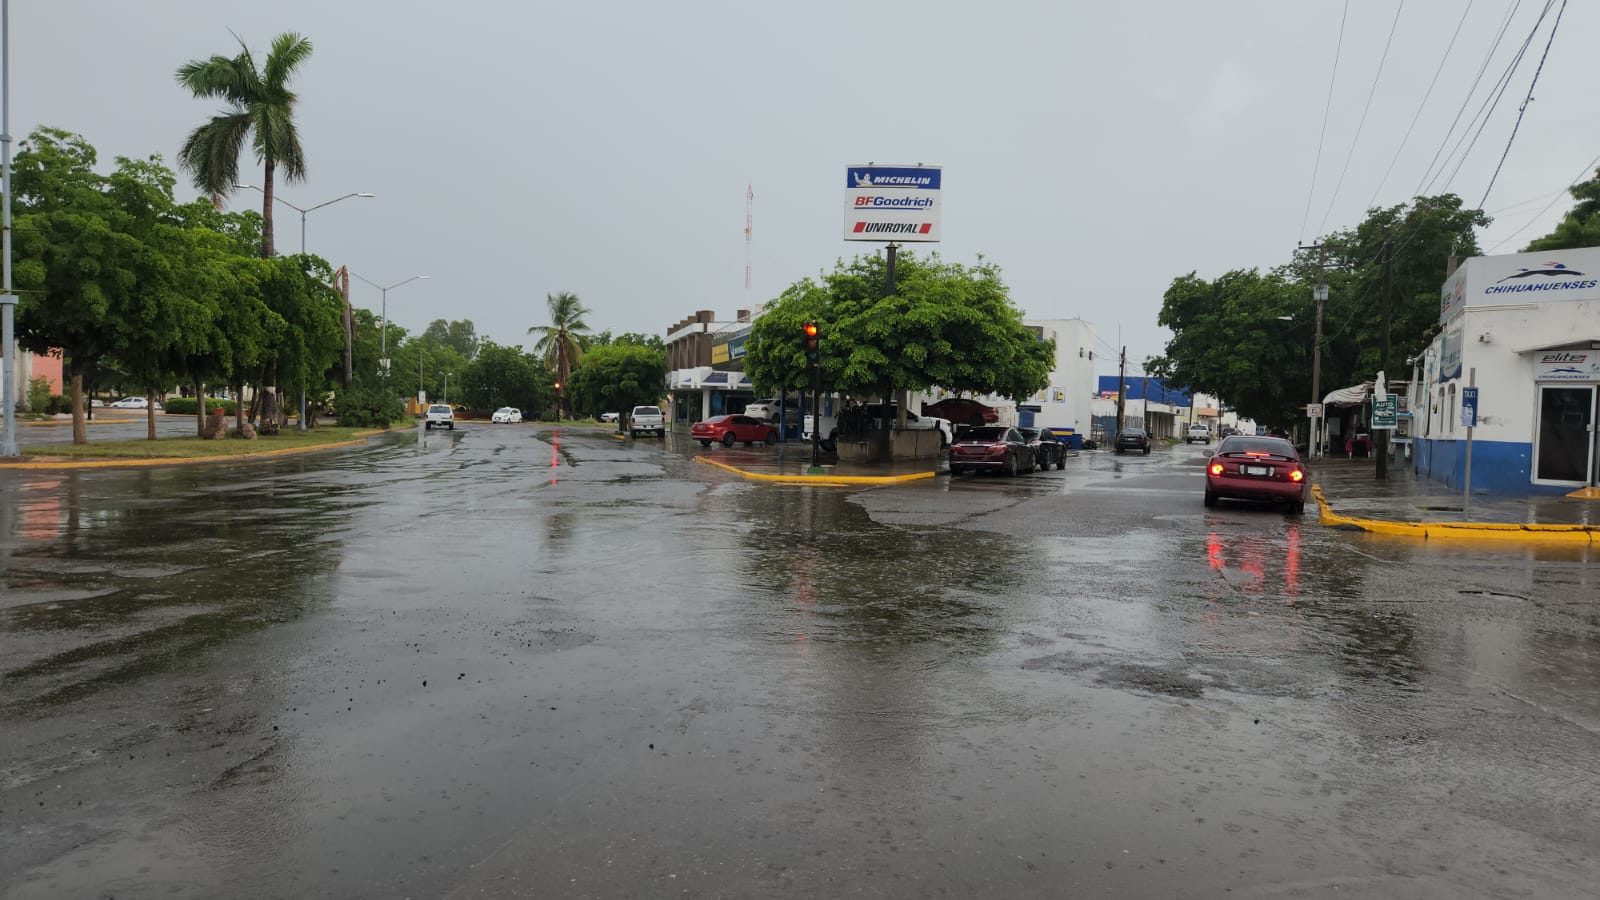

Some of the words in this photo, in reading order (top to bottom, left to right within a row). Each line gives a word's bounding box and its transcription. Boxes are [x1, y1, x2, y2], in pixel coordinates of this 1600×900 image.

[874, 176, 931, 185] MICHELIN
[854, 196, 933, 207] BFGoodrich
[865, 222, 918, 233] UNIROYAL
[1484, 279, 1598, 295] CHIHUAHUENSES
